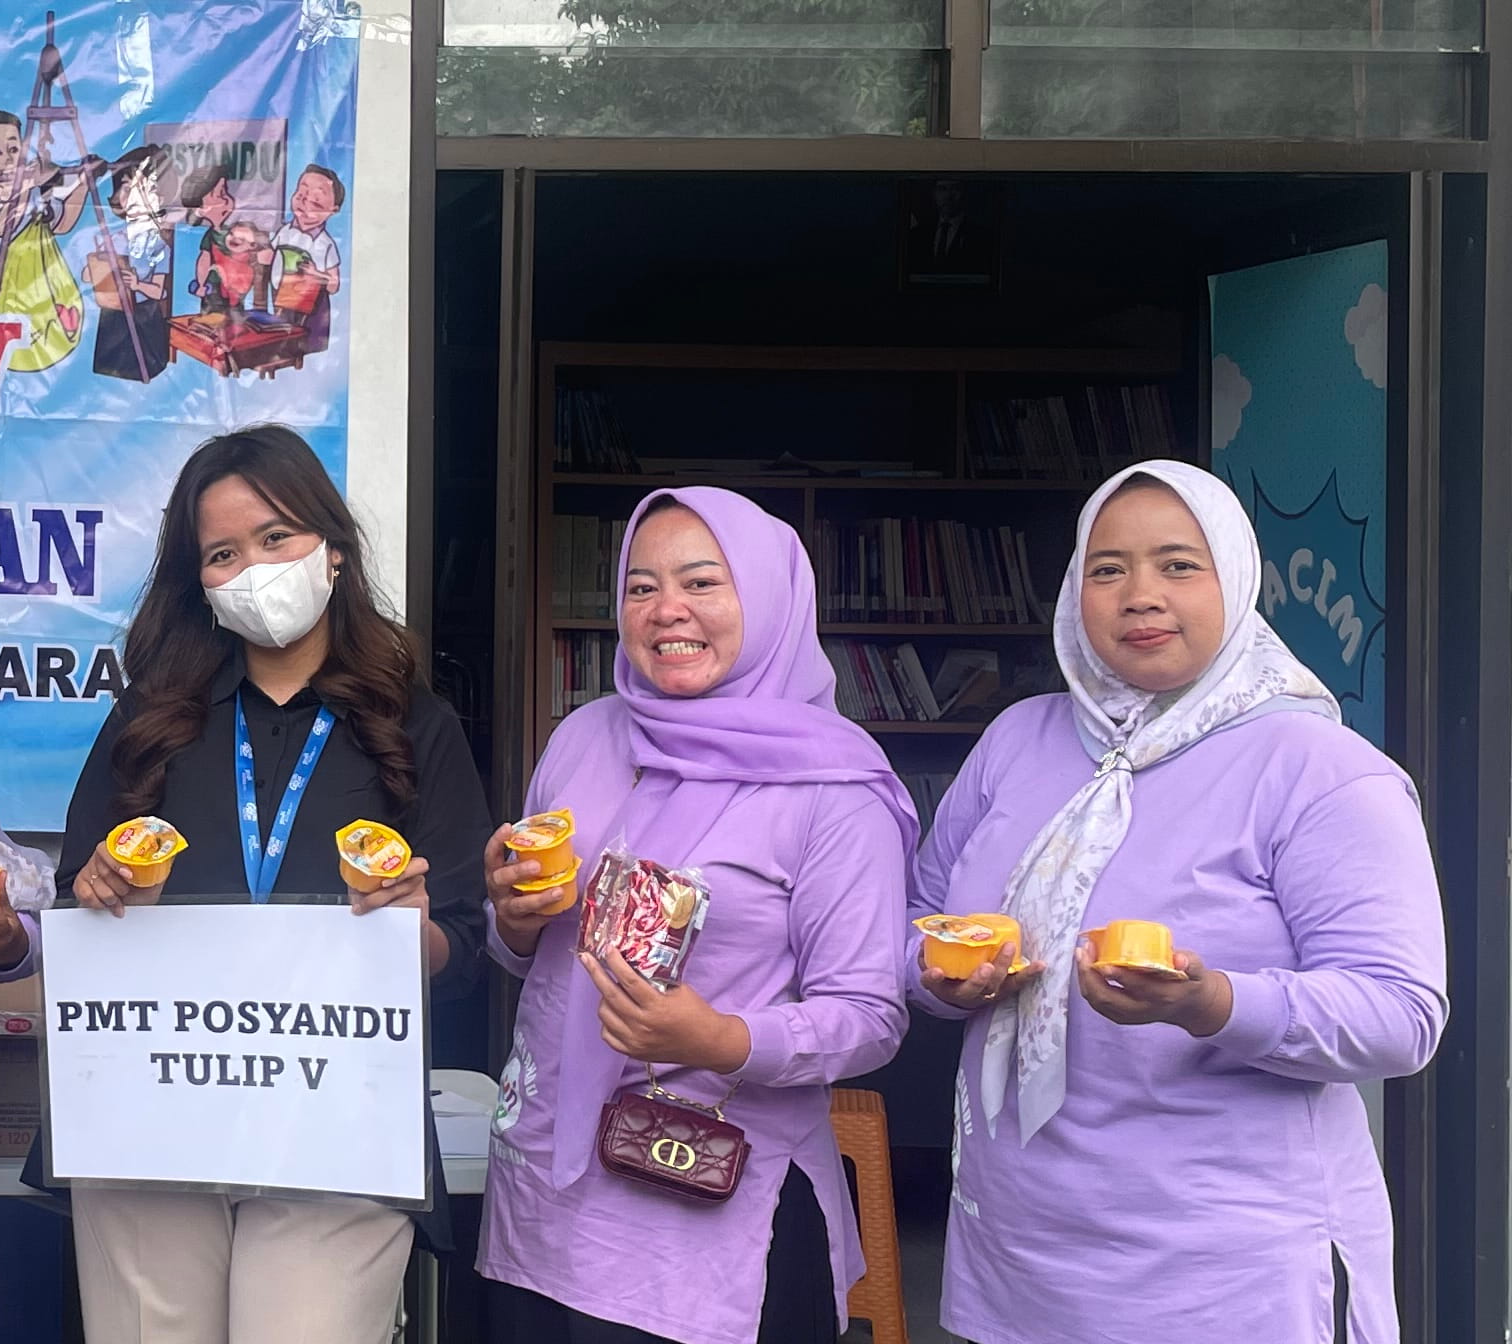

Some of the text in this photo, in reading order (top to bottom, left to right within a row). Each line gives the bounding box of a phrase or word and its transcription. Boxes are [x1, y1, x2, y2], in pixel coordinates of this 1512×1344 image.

[56, 1000, 159, 1032] PMT
[174, 1000, 411, 1041] POSYANDU
[150, 1052, 328, 1090] TULIP V
